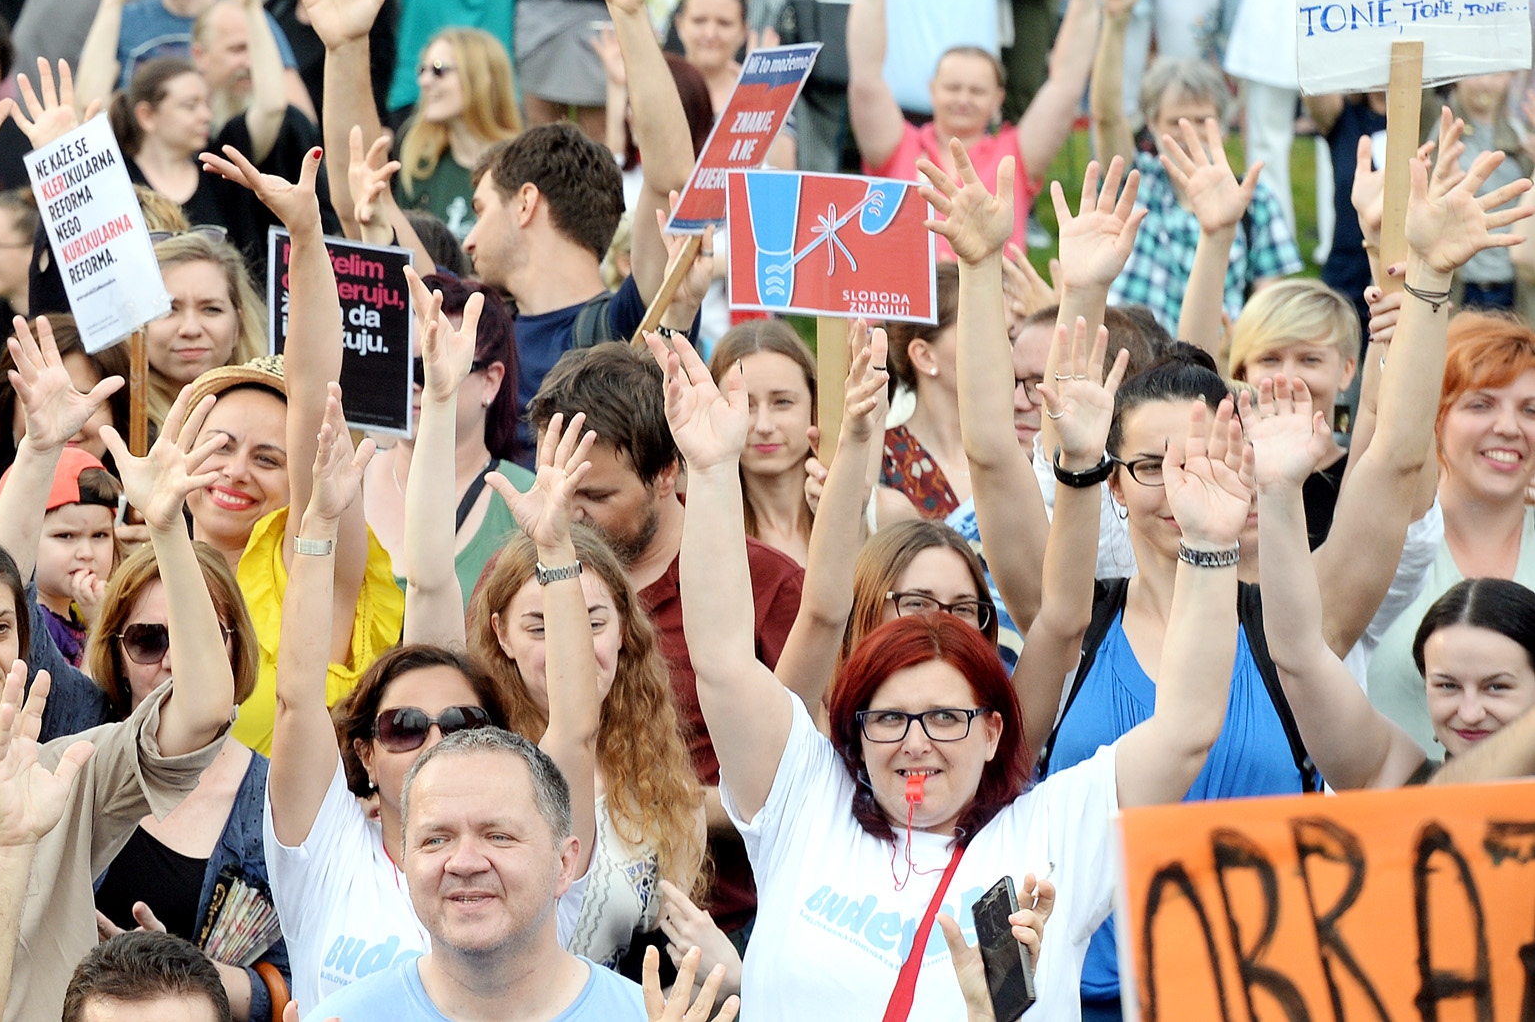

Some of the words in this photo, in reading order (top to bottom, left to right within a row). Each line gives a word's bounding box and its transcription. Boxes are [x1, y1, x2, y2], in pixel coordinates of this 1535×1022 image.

[1402, 0, 1463, 22] TONE,
[759, 56, 771, 74] to
[730, 110, 776, 135] ZNANJE,
[35, 154, 50, 180] NE
[50, 144, 73, 174] KAŽE
[74, 137, 90, 157] SE
[728, 139, 742, 161] A
[737, 138, 758, 161] NE
[41, 148, 116, 201] KLERIKULARNA
[48, 185, 94, 222] REFORMA
[55, 216, 82, 243] NEGO
[62, 214, 133, 265] KURIKULARNA
[68, 248, 118, 286] REFORMA.
[842, 290, 911, 306] SLOBODA
[348, 304, 381, 328] da
